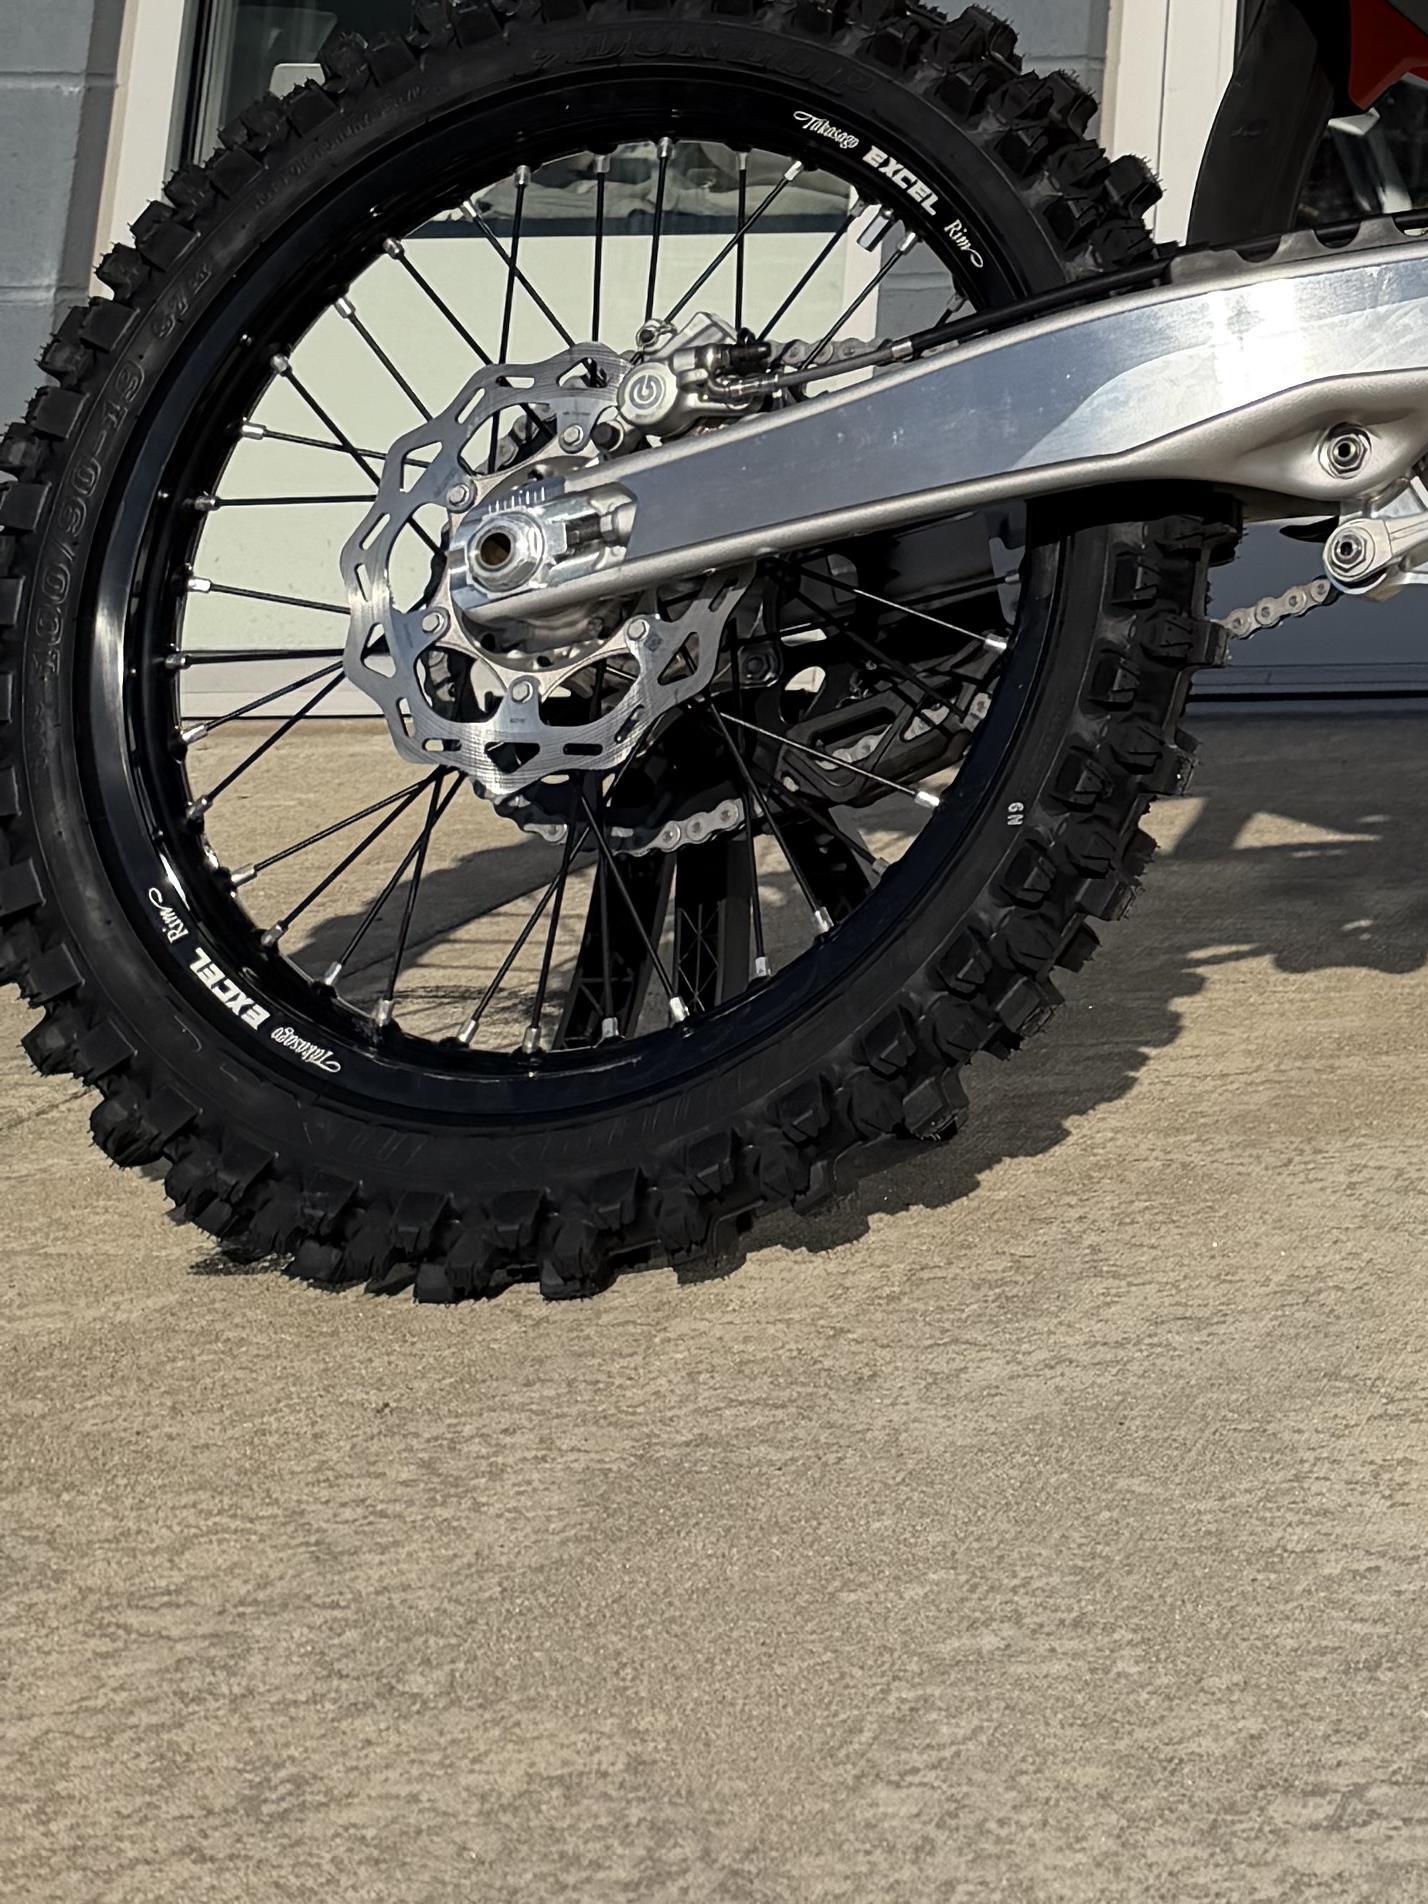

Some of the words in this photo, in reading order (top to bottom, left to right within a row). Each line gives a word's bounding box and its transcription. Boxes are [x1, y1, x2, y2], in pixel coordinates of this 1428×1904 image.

[793, 110, 861, 149] Takasago
[862, 145, 939, 216] EXCEL
[944, 218, 984, 268] Rim
[148, 887, 190, 944] Rim
[189, 947, 271, 1031] EXCEL
[270, 1026, 342, 1073] Takasago
